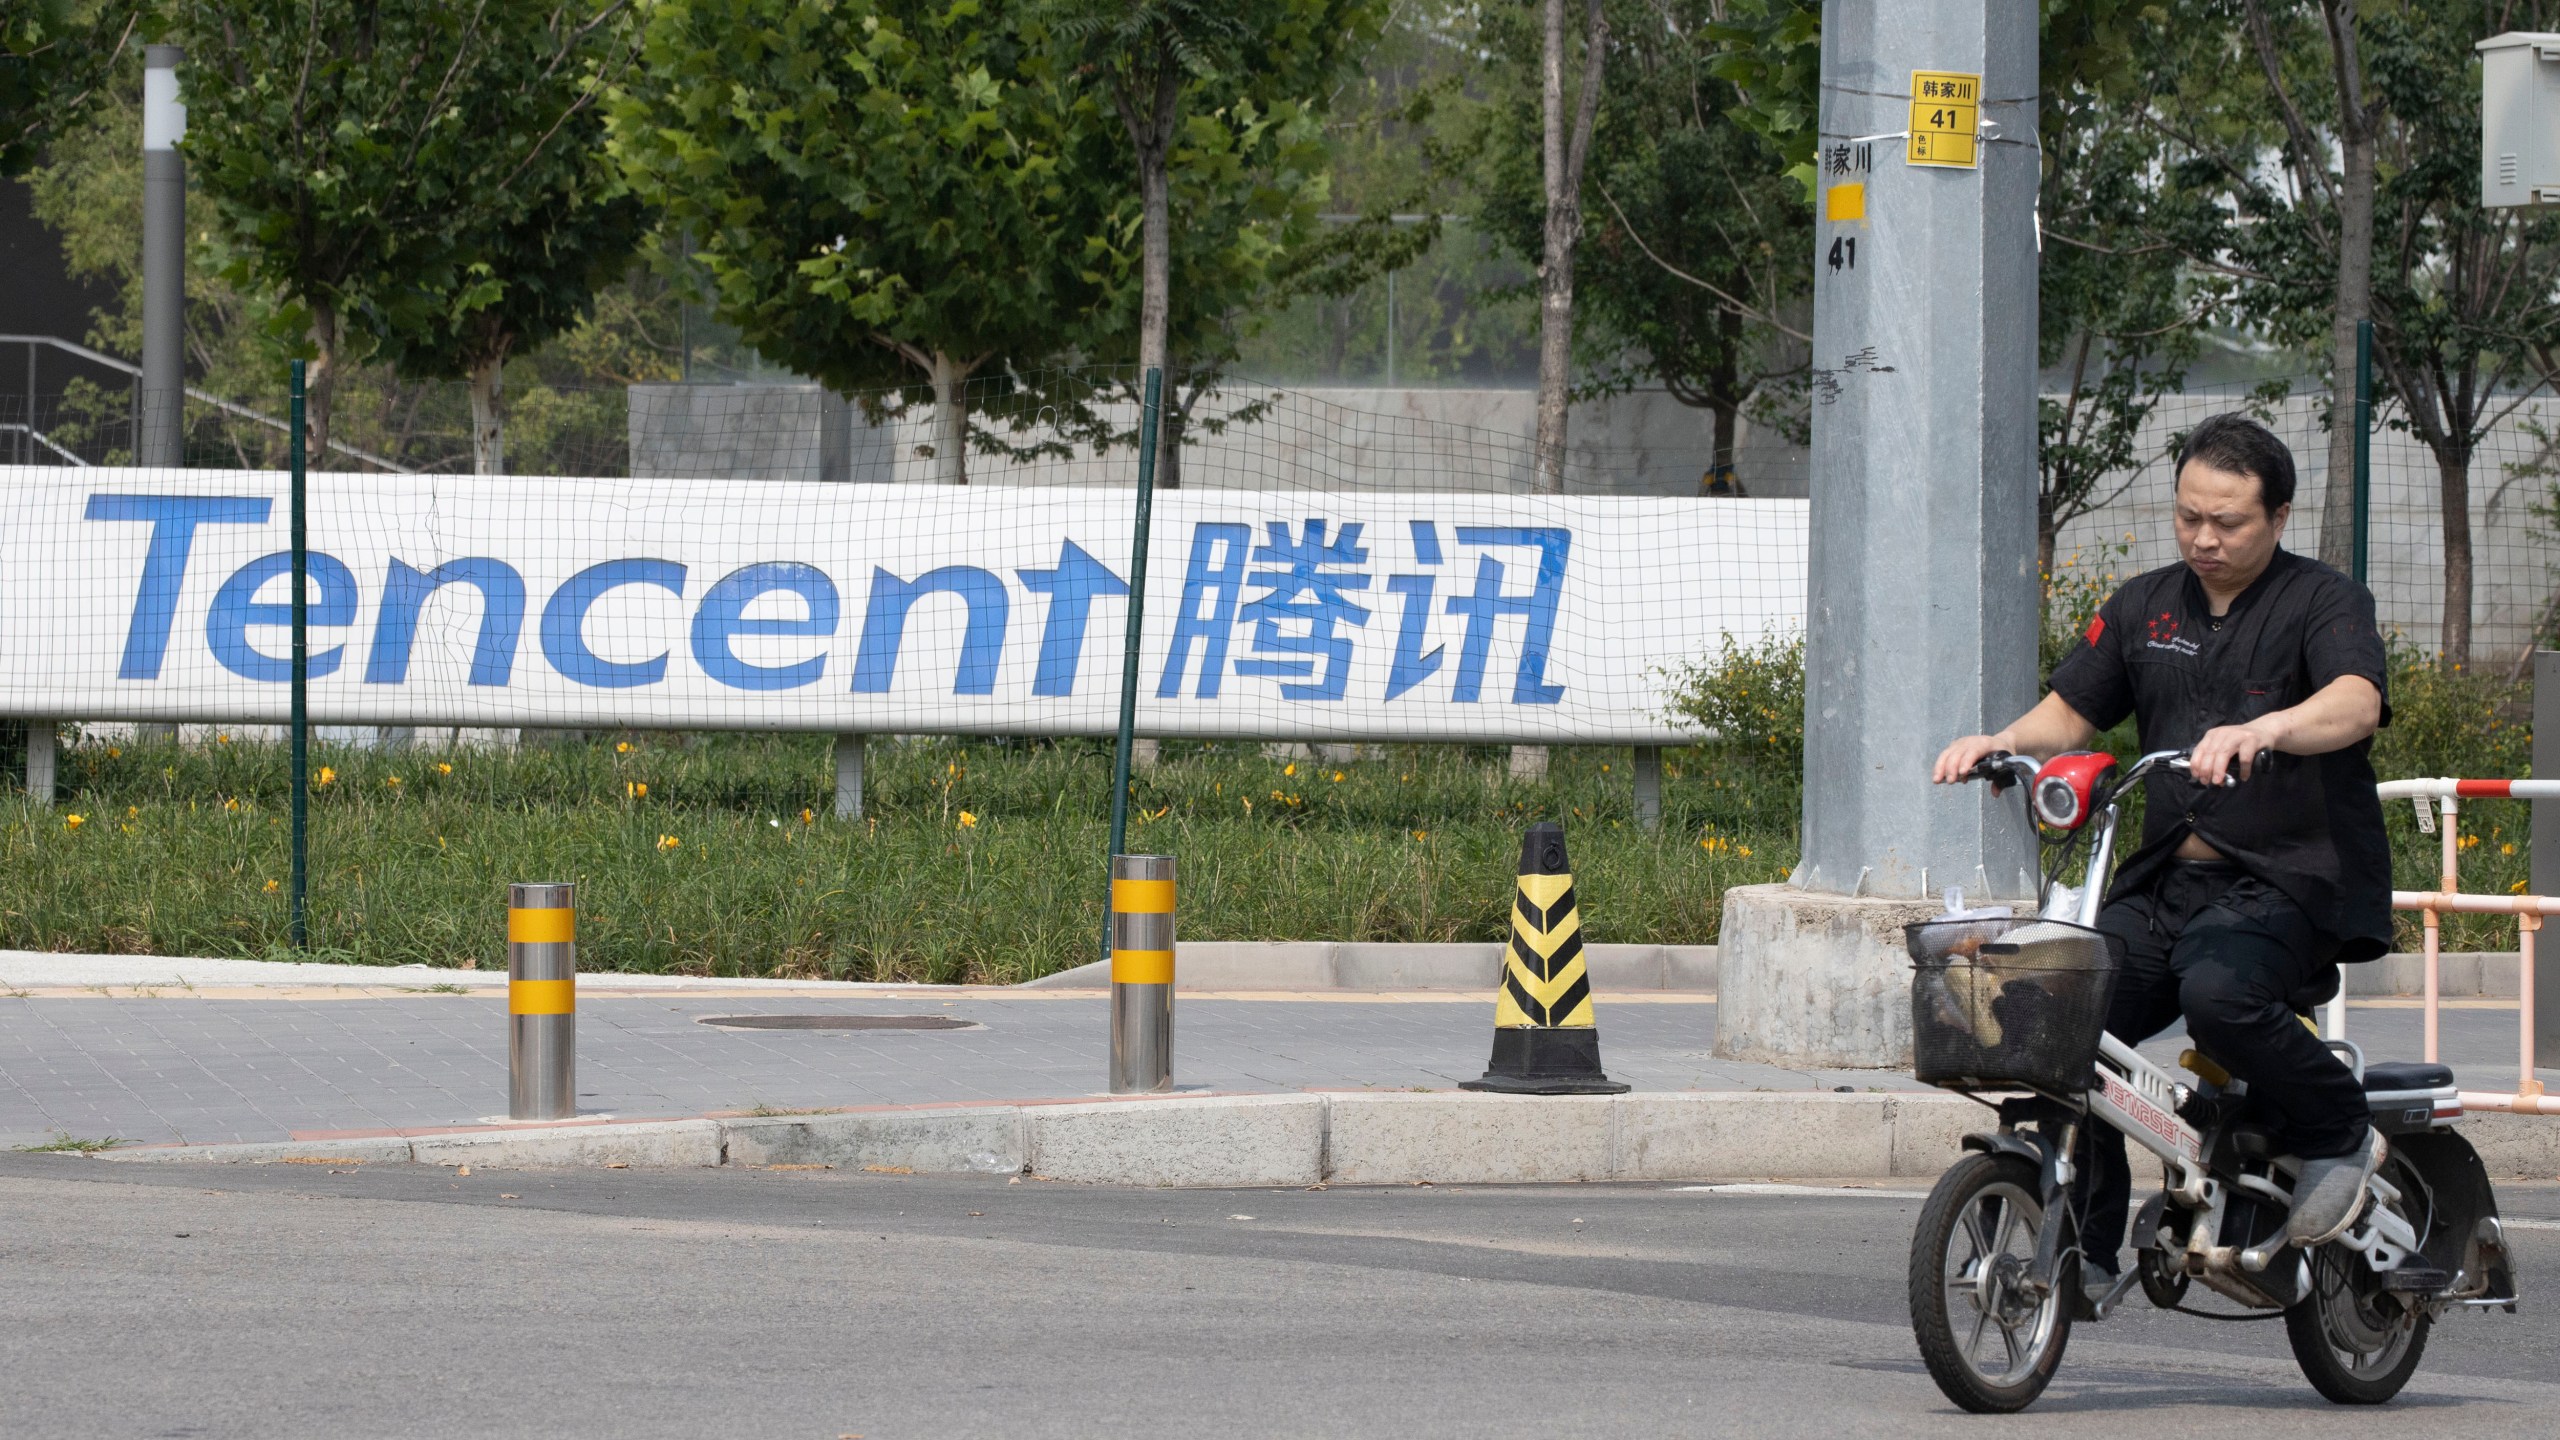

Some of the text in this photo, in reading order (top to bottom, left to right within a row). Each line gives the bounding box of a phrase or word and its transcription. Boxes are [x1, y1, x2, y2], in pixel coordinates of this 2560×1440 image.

[1922, 80, 1971, 99] 韩家川
[1930, 109, 1956, 129] 41
[1828, 236, 1855, 272] 41
[84, 493, 1572, 705] Tencent 腾讯
